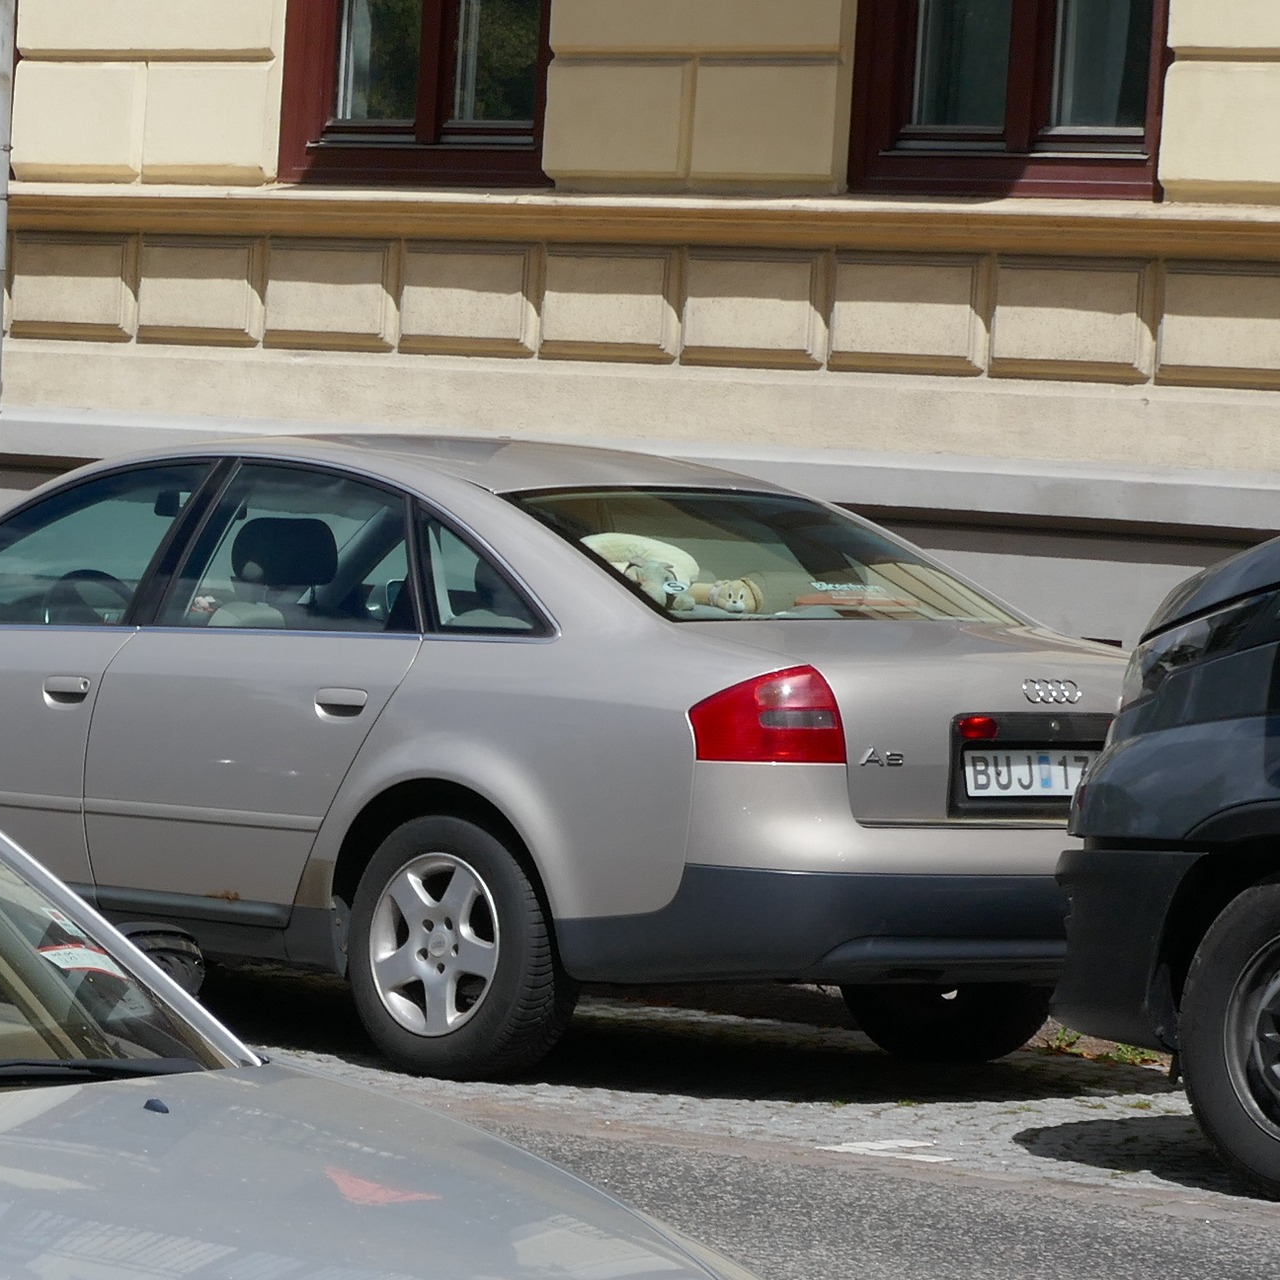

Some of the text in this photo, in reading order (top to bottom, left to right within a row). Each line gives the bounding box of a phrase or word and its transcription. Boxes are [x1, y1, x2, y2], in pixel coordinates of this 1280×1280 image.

[666, 582, 685, 592] S
[971, 755, 1089, 791] BUJ 17
